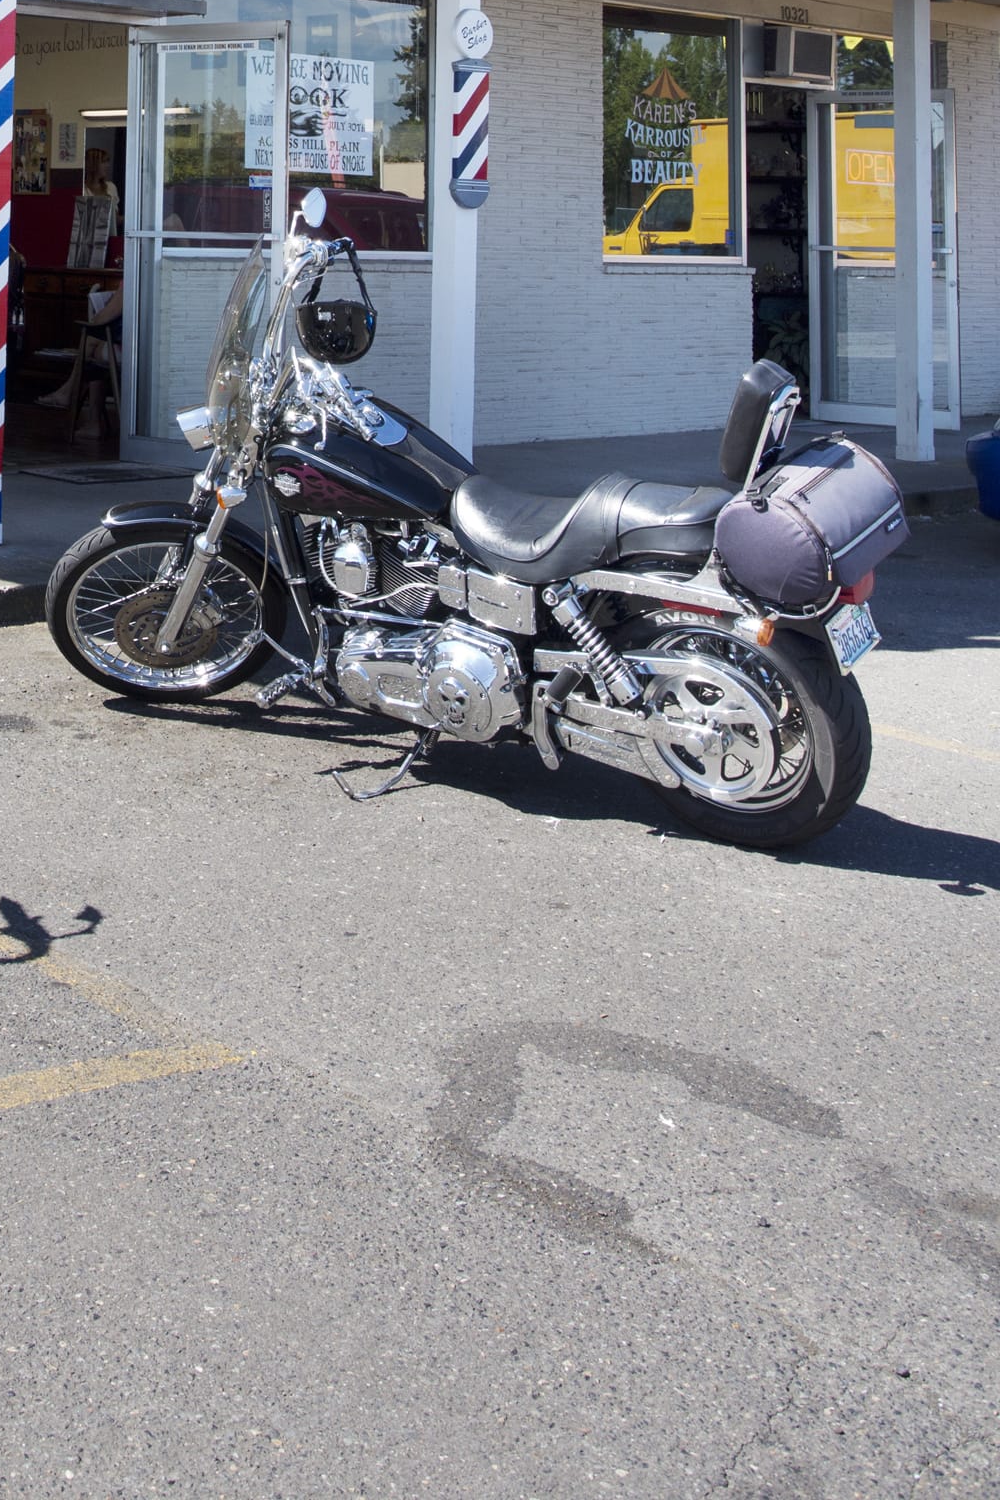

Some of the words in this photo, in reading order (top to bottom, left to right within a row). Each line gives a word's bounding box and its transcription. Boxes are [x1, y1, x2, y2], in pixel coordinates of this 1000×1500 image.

[780, 6, 809, 23] 10321
[461, 19, 487, 39] Barber
[467, 34, 487, 49] Shop
[251, 56, 275, 76] WE
[289, 59, 308, 80] RE
[313, 60, 369, 85] MOVING
[632, 95, 697, 124] KAREN'S
[624, 117, 707, 148] KARROUSEL
[258, 136, 299, 149] ACSS
[302, 139, 326, 151] MILL
[329, 141, 360, 153] PLAIN
[304, 153, 328, 170] HOUSE
[330, 154, 340, 171] OF
[341, 155, 366, 172] SMOKE
[631, 159, 703, 187] BEAUTY
[654, 610, 716, 627] AVON
